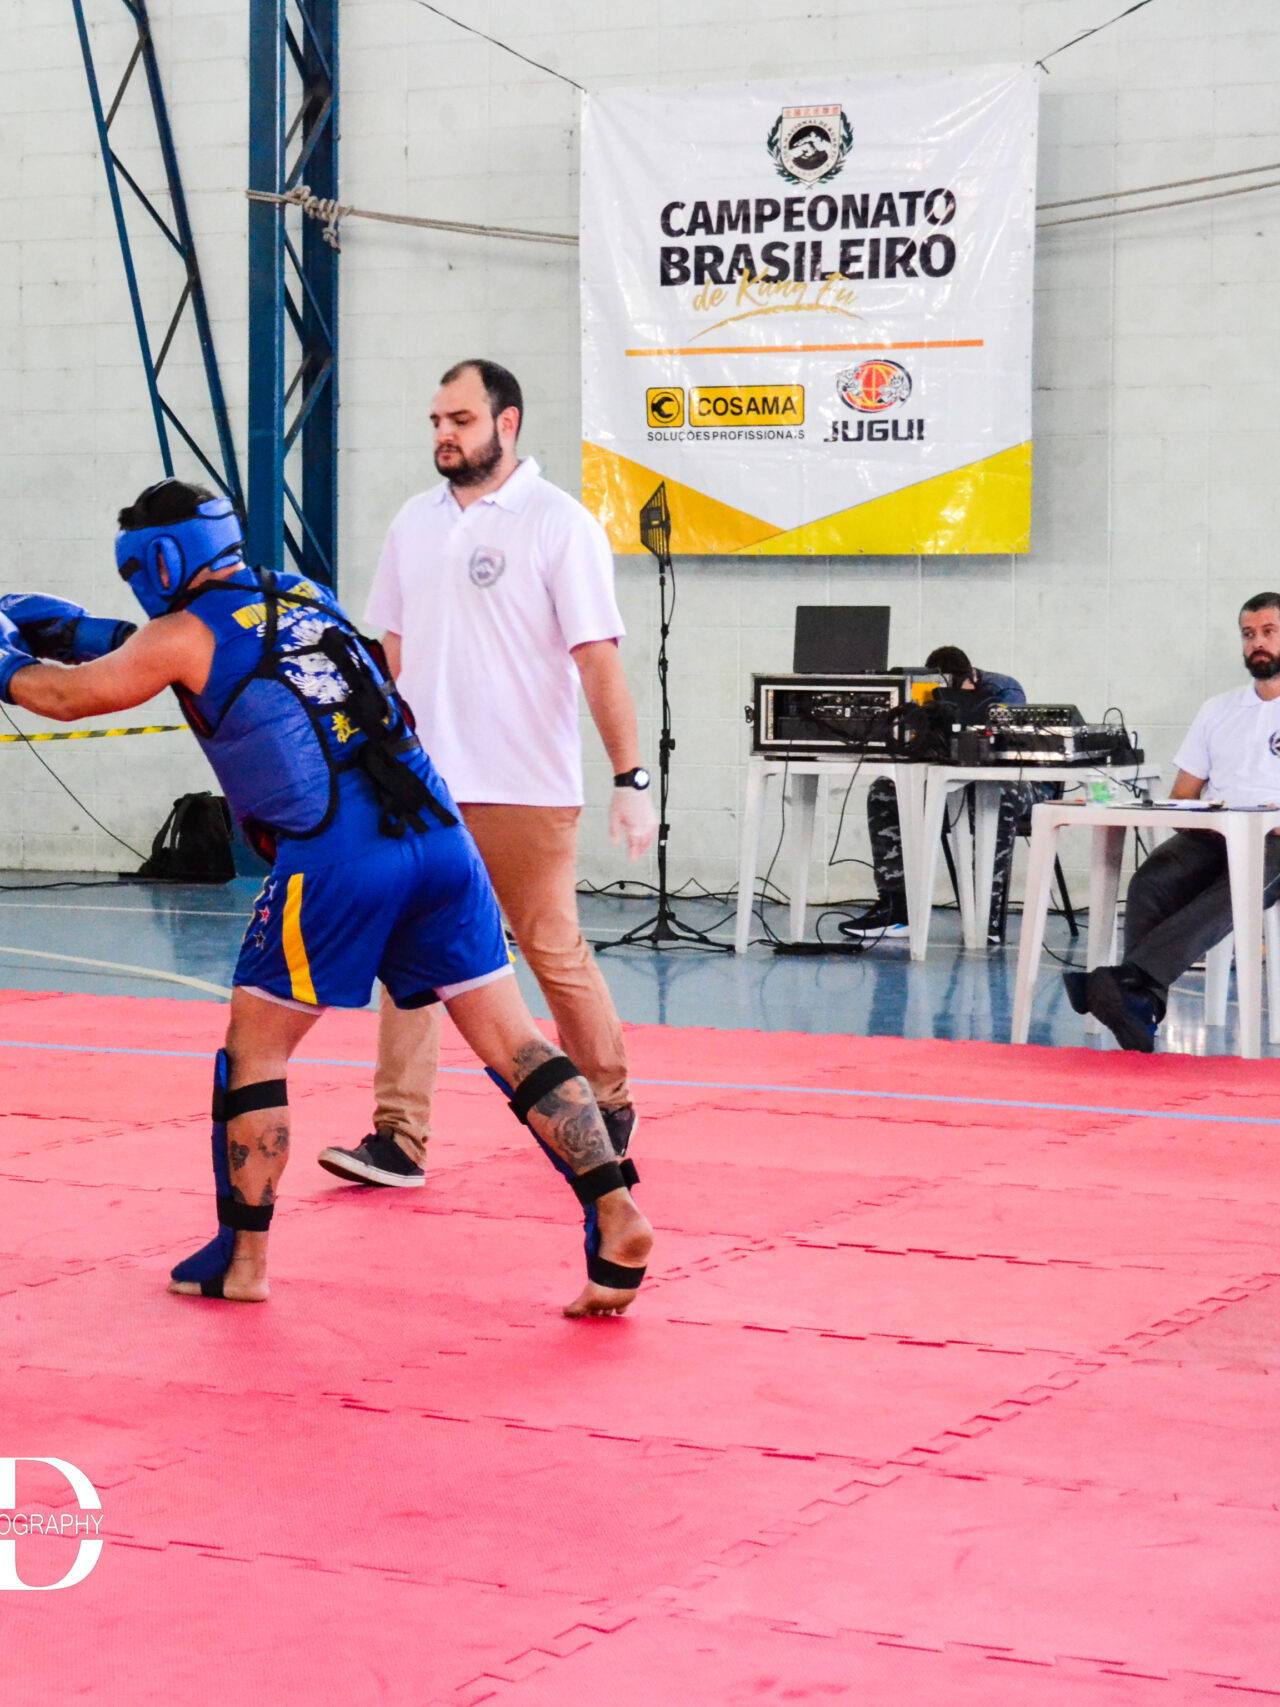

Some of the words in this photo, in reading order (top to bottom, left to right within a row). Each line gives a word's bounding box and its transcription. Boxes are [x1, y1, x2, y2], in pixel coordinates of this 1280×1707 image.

[660, 188, 956, 237] CAMPEONATO
[660, 233, 956, 287] BRASILEIRO
[693, 279, 728, 311] de
[736, 268, 808, 307] Kung
[816, 272, 858, 306] Fu
[698, 396, 798, 416] COSAMA
[823, 419, 925, 443] JUGUI
